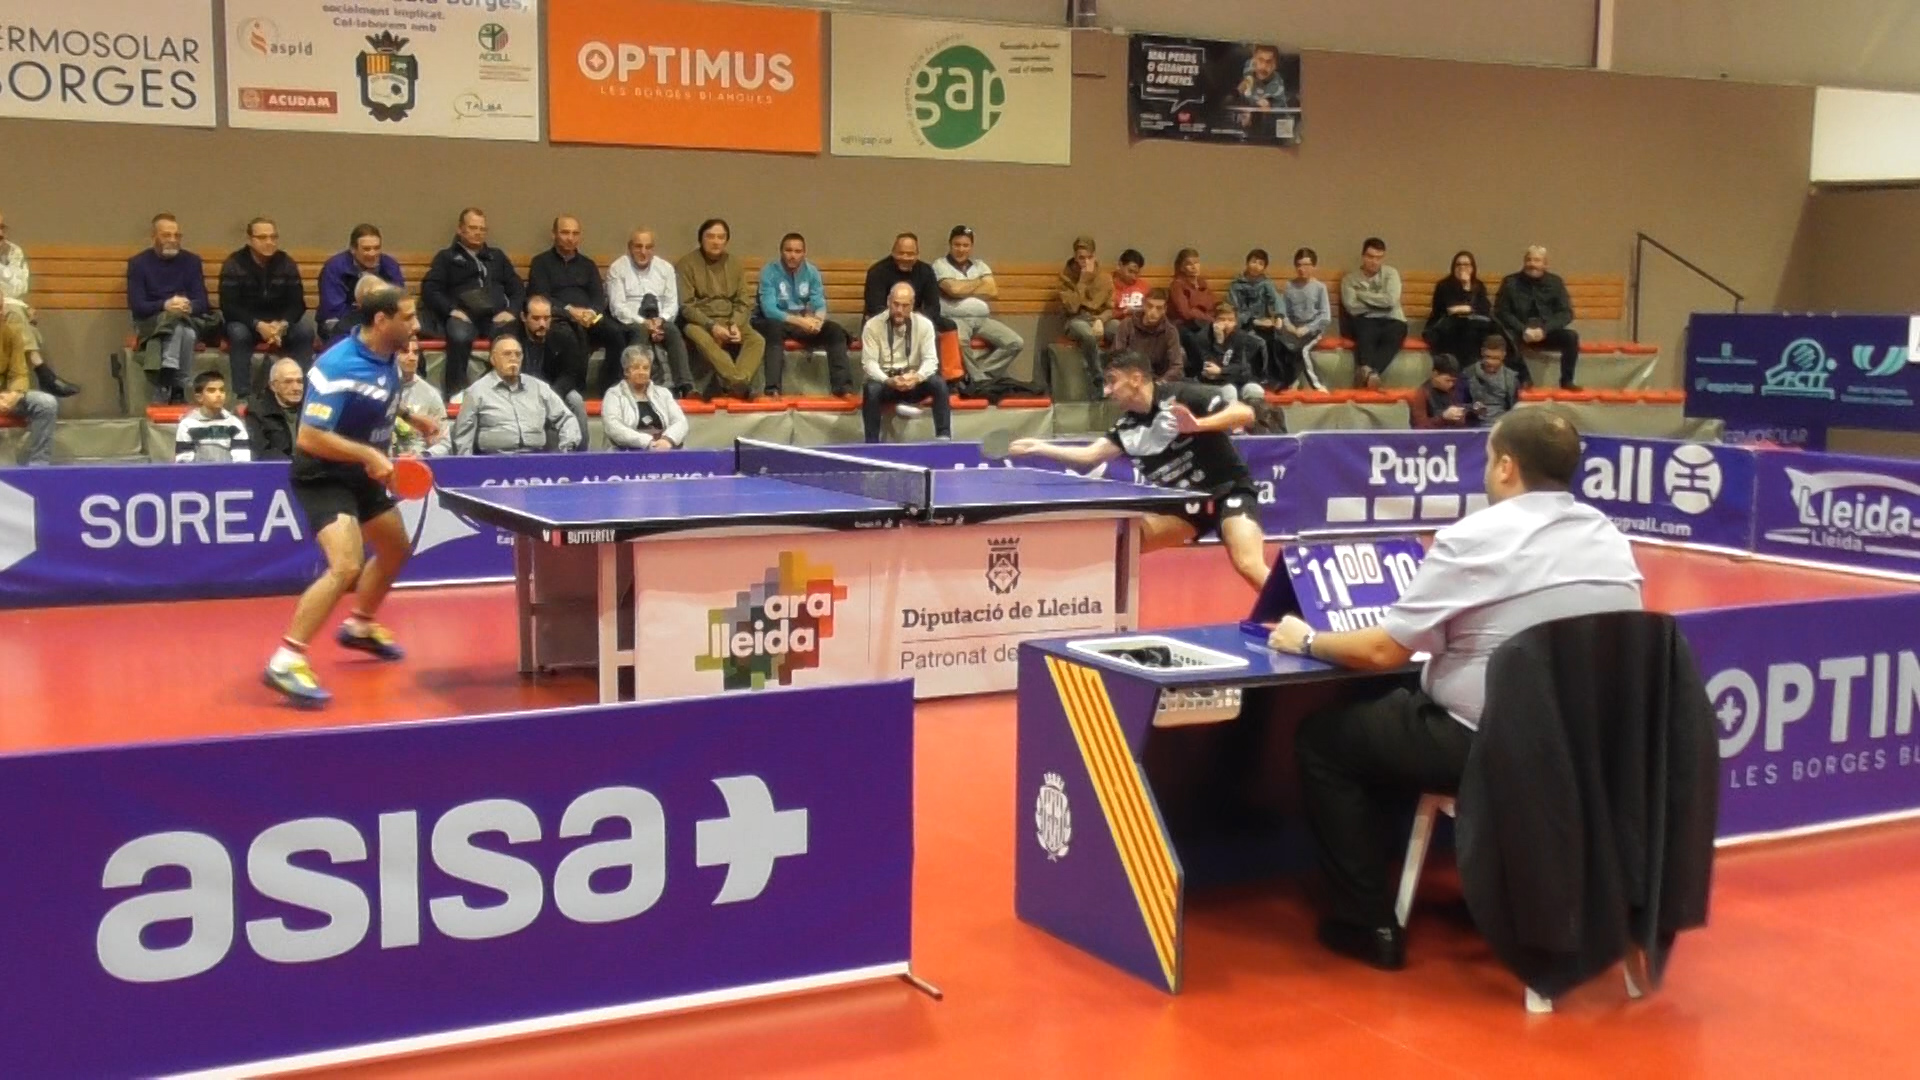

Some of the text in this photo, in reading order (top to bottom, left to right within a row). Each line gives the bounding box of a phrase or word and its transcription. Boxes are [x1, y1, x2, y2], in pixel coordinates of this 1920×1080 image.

[0, 25, 200, 64] RMOSOLAR
[0, 60, 197, 110] ORGES
[577, 41, 794, 92] OPTIMUS
[268, 94, 331, 108] ACUDAM
[600, 85, 626, 97] LES
[634, 88, 691, 101] BORGES
[914, 67, 1006, 131] gap
[1369, 444, 1460, 493] Pujol
[1580, 440, 1654, 505] all
[79, 488, 303, 549] SOREA
[567, 528, 616, 544] BUTTERFLY
[1307, 557, 1353, 608] 11
[764, 592, 832, 620] ara
[902, 597, 1103, 631] Diputació de Lleida
[711, 618, 815, 659] lleida
[900, 643, 1018, 670] Patronat de
[1730, 763, 1778, 789] LES
[1792, 748, 1887, 782] BORGES
[96, 785, 667, 985] asisa
